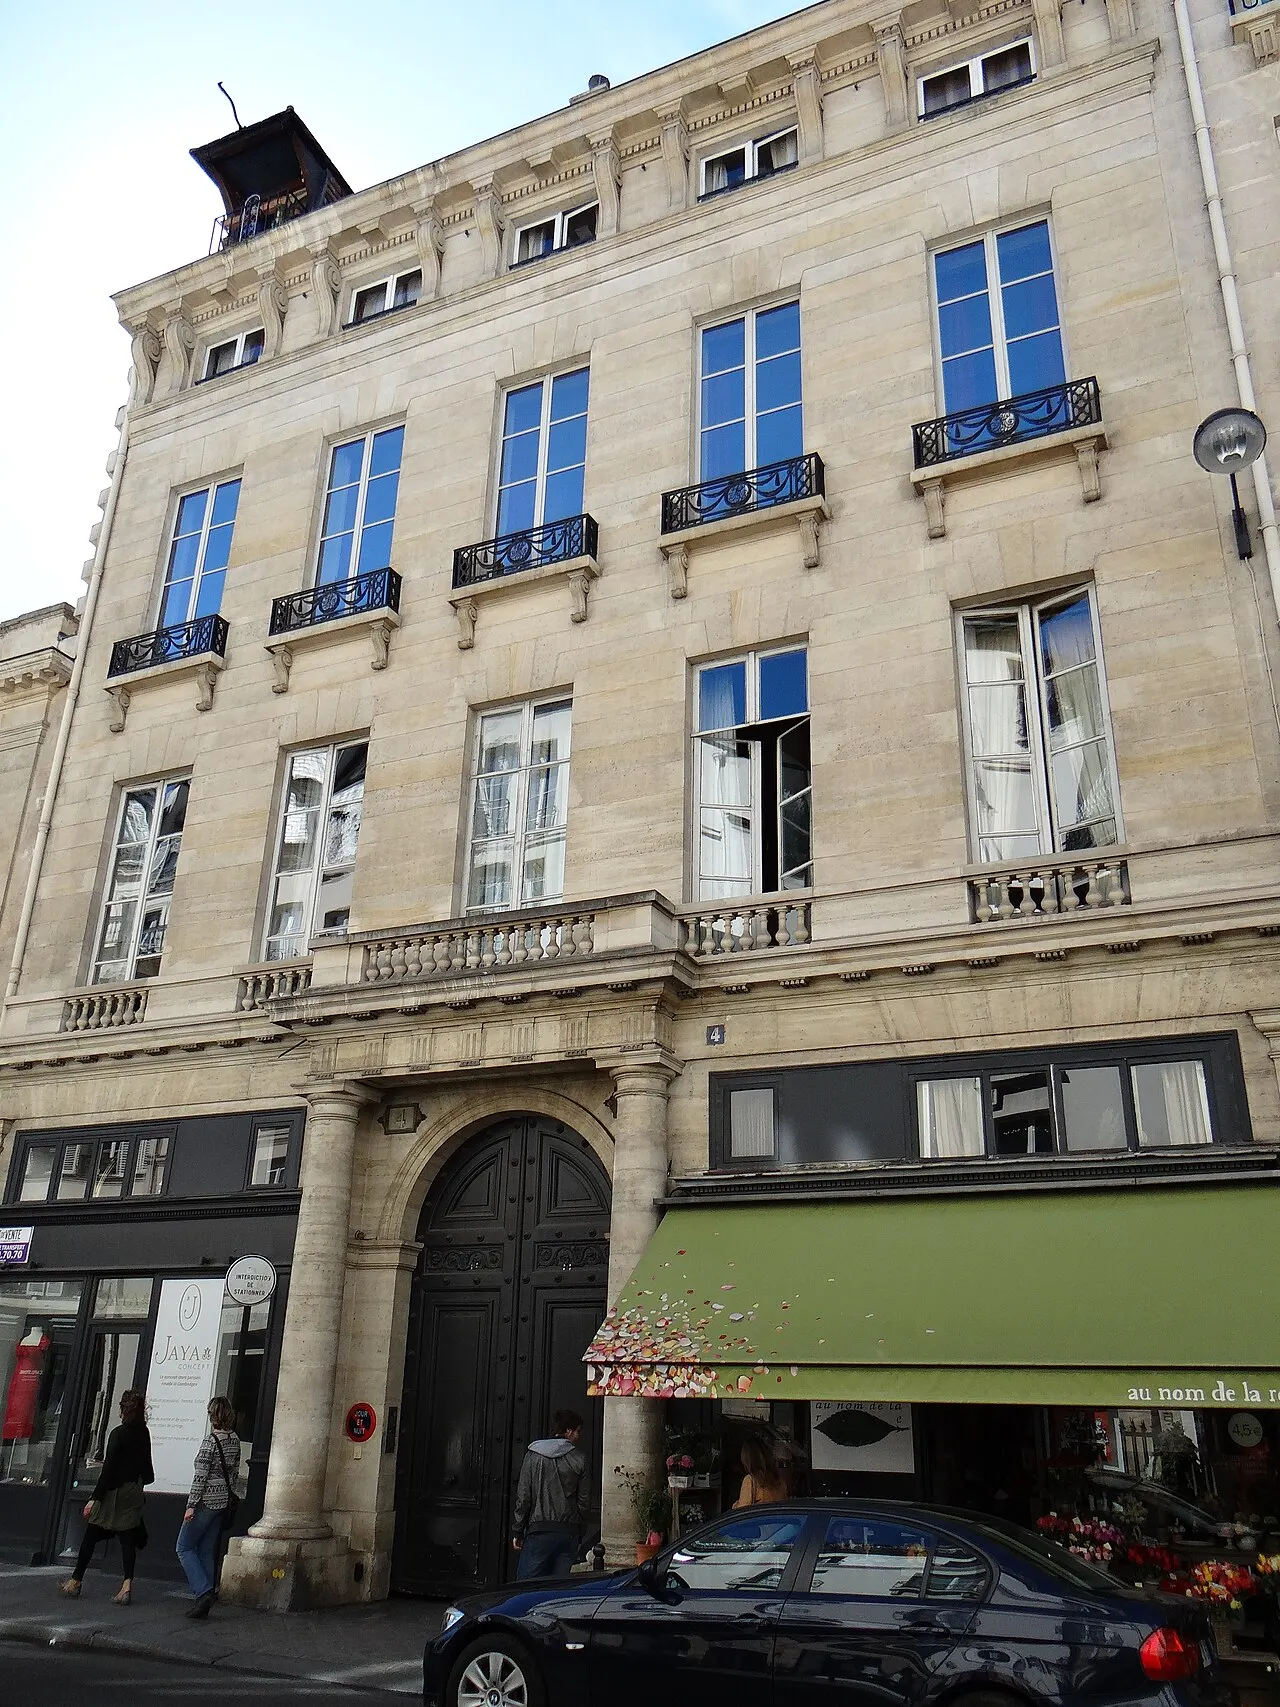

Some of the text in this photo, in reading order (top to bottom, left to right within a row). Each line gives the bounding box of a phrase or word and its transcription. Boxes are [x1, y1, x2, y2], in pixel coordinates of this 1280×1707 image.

[710, 1027, 721, 1042] 4
[5, 1229, 22, 1240] VENTE
[235, 1274, 271, 1282] INTERDICTION
[233, 1288, 266, 1296] STATIONNER
[1127, 1386, 1151, 1401] au
[1158, 1387, 1205, 1402] nom
[1211, 1380, 1236, 1402] de
[1242, 1381, 1262, 1402] la
[836, 1402, 865, 1410] nom
[869, 1402, 884, 1410] de
[353, 1427, 366, 1435] NUIT
